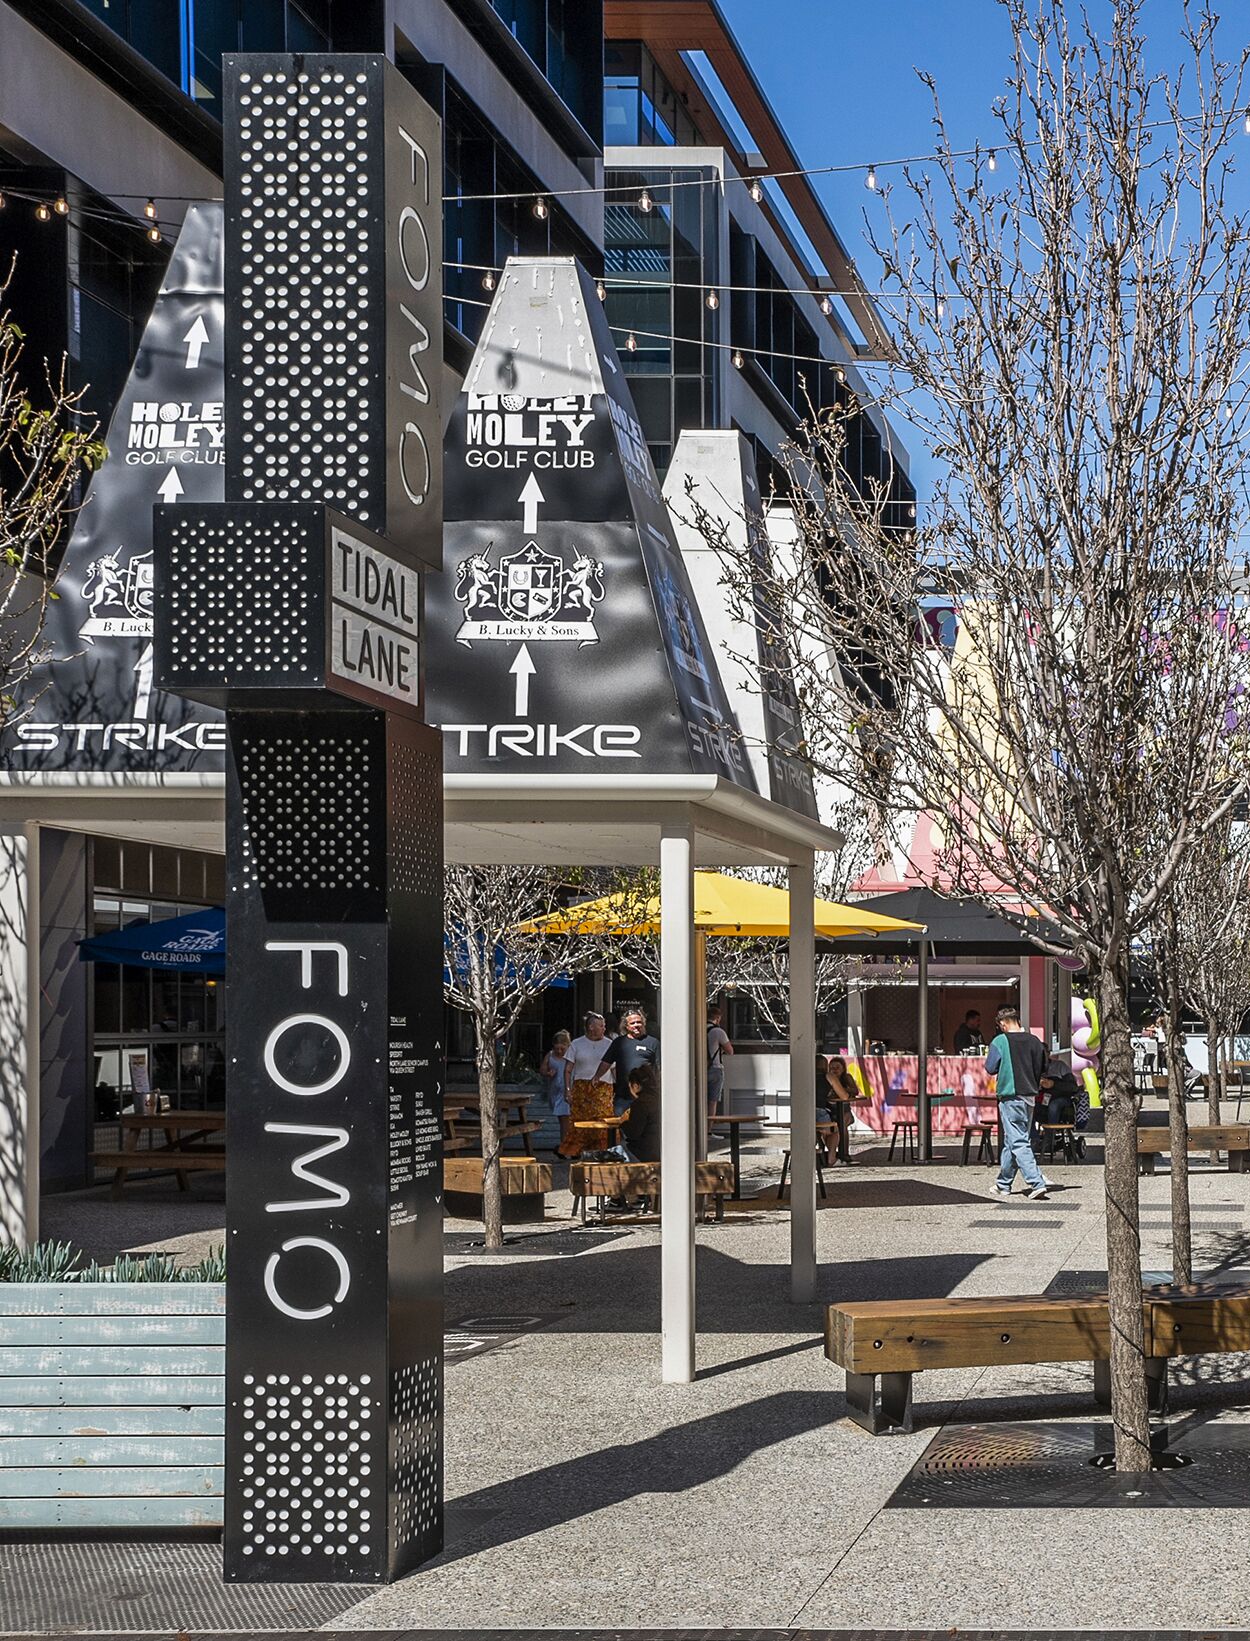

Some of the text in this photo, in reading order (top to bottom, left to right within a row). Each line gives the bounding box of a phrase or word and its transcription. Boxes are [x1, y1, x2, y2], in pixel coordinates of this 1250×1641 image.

[398, 124, 430, 507] FOMO
[131, 402, 224, 422] HOLE
[127, 422, 225, 449] MOLEY
[466, 413, 595, 447] MOLEY
[125, 450, 176, 465] GOLF
[465, 449, 595, 469] GOLF CLUB
[338, 541, 414, 624] TIDAL
[103, 621, 152, 632] B. Luck
[479, 624, 580, 638] B. Lucky & Sons
[342, 619, 411, 693] LANE
[12, 723, 226, 751] STRIKE
[431, 723, 642, 758] TRIKE
[141, 950, 169, 962] GAGE
[170, 953, 202, 963] ROADS
[263, 940, 351, 1321] FOMO
